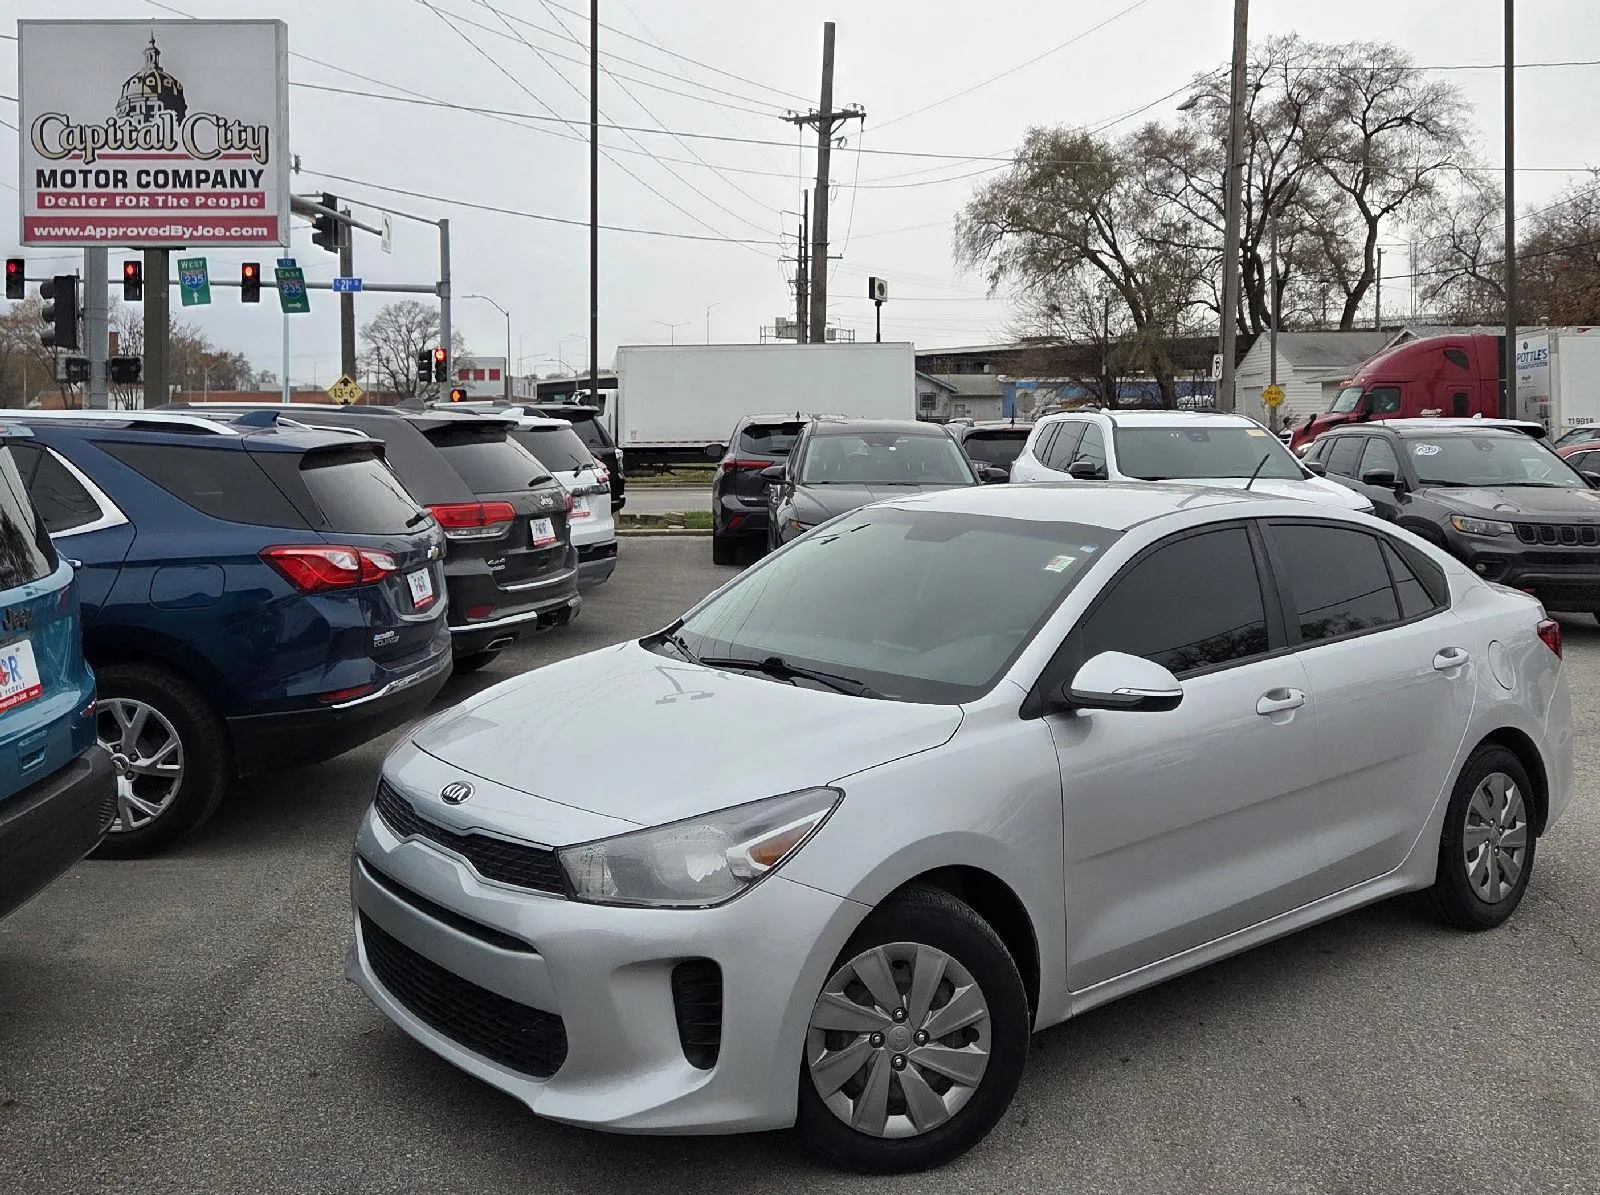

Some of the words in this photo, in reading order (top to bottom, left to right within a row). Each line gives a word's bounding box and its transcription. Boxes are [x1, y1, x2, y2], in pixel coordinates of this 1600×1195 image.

[31, 112, 178, 165] Capital
[182, 112, 269, 165] City
[36, 169, 128, 189] MOTOR
[136, 169, 264, 189] COMPANY
[44, 195, 107, 207] Dealer
[115, 195, 150, 207] FOR
[155, 195, 189, 207] The
[195, 195, 260, 208] People
[34, 225, 268, 240] www.ApprovedByJoe.com
[184, 274, 204, 285] 235
[283, 284, 301, 293] 235
[442, 783, 469, 801] KIA
